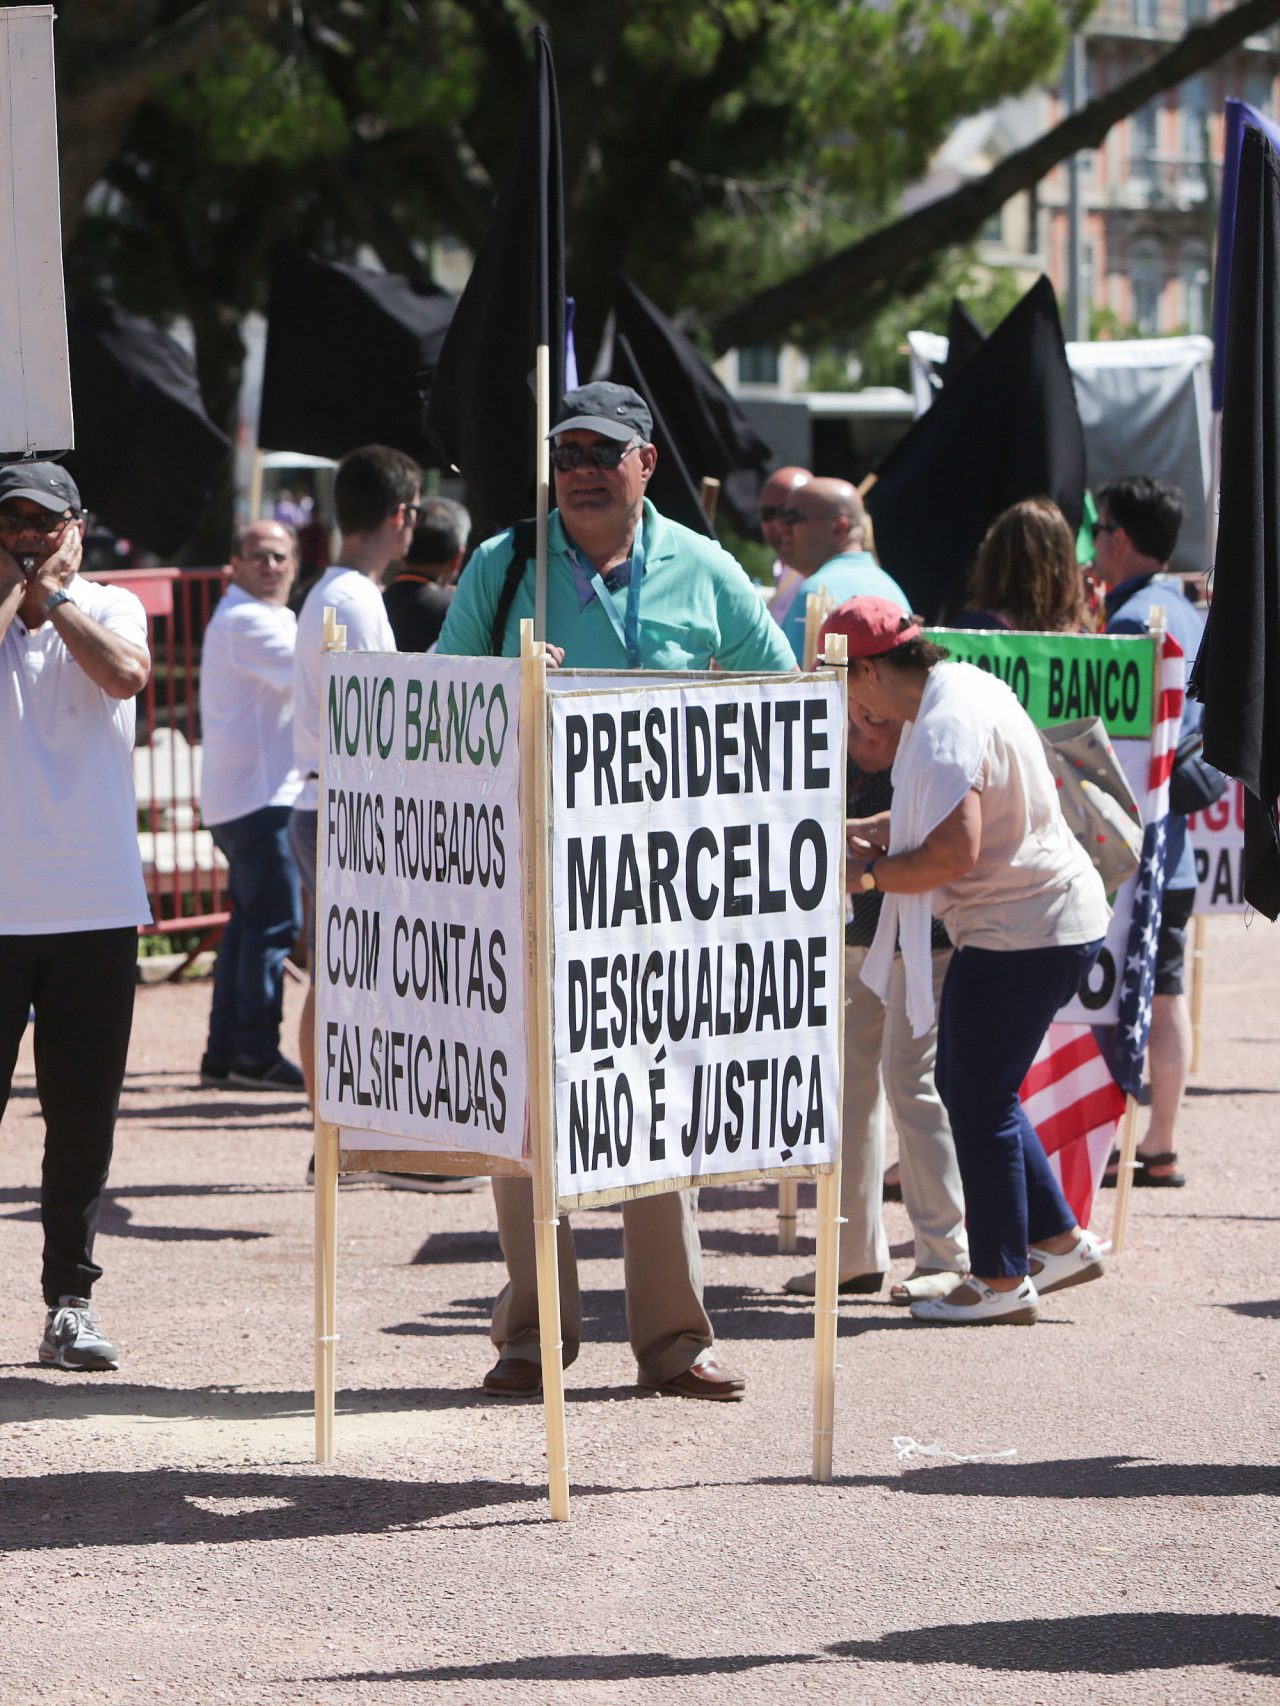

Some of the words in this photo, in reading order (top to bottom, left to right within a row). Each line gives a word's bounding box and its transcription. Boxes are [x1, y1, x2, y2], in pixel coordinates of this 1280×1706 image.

[328, 674, 396, 761] NOVO
[404, 677, 509, 768] BANCO
[1047, 656, 1141, 723] BANCO
[565, 698, 831, 809] PRESIDENTE
[327, 788, 386, 876] FOMOS
[394, 796, 506, 889] ROUBADOS
[567, 818, 829, 931] MARCELO
[326, 904, 381, 992] COM
[392, 915, 507, 1014] CONTAS
[568, 936, 828, 1053] DESIGUALDADE
[325, 1021, 509, 1135] FALSIFICADAS
[569, 1055, 633, 1176] NÃO
[648, 1044, 667, 1162] É
[680, 1053, 826, 1162] JUSTIÇA
